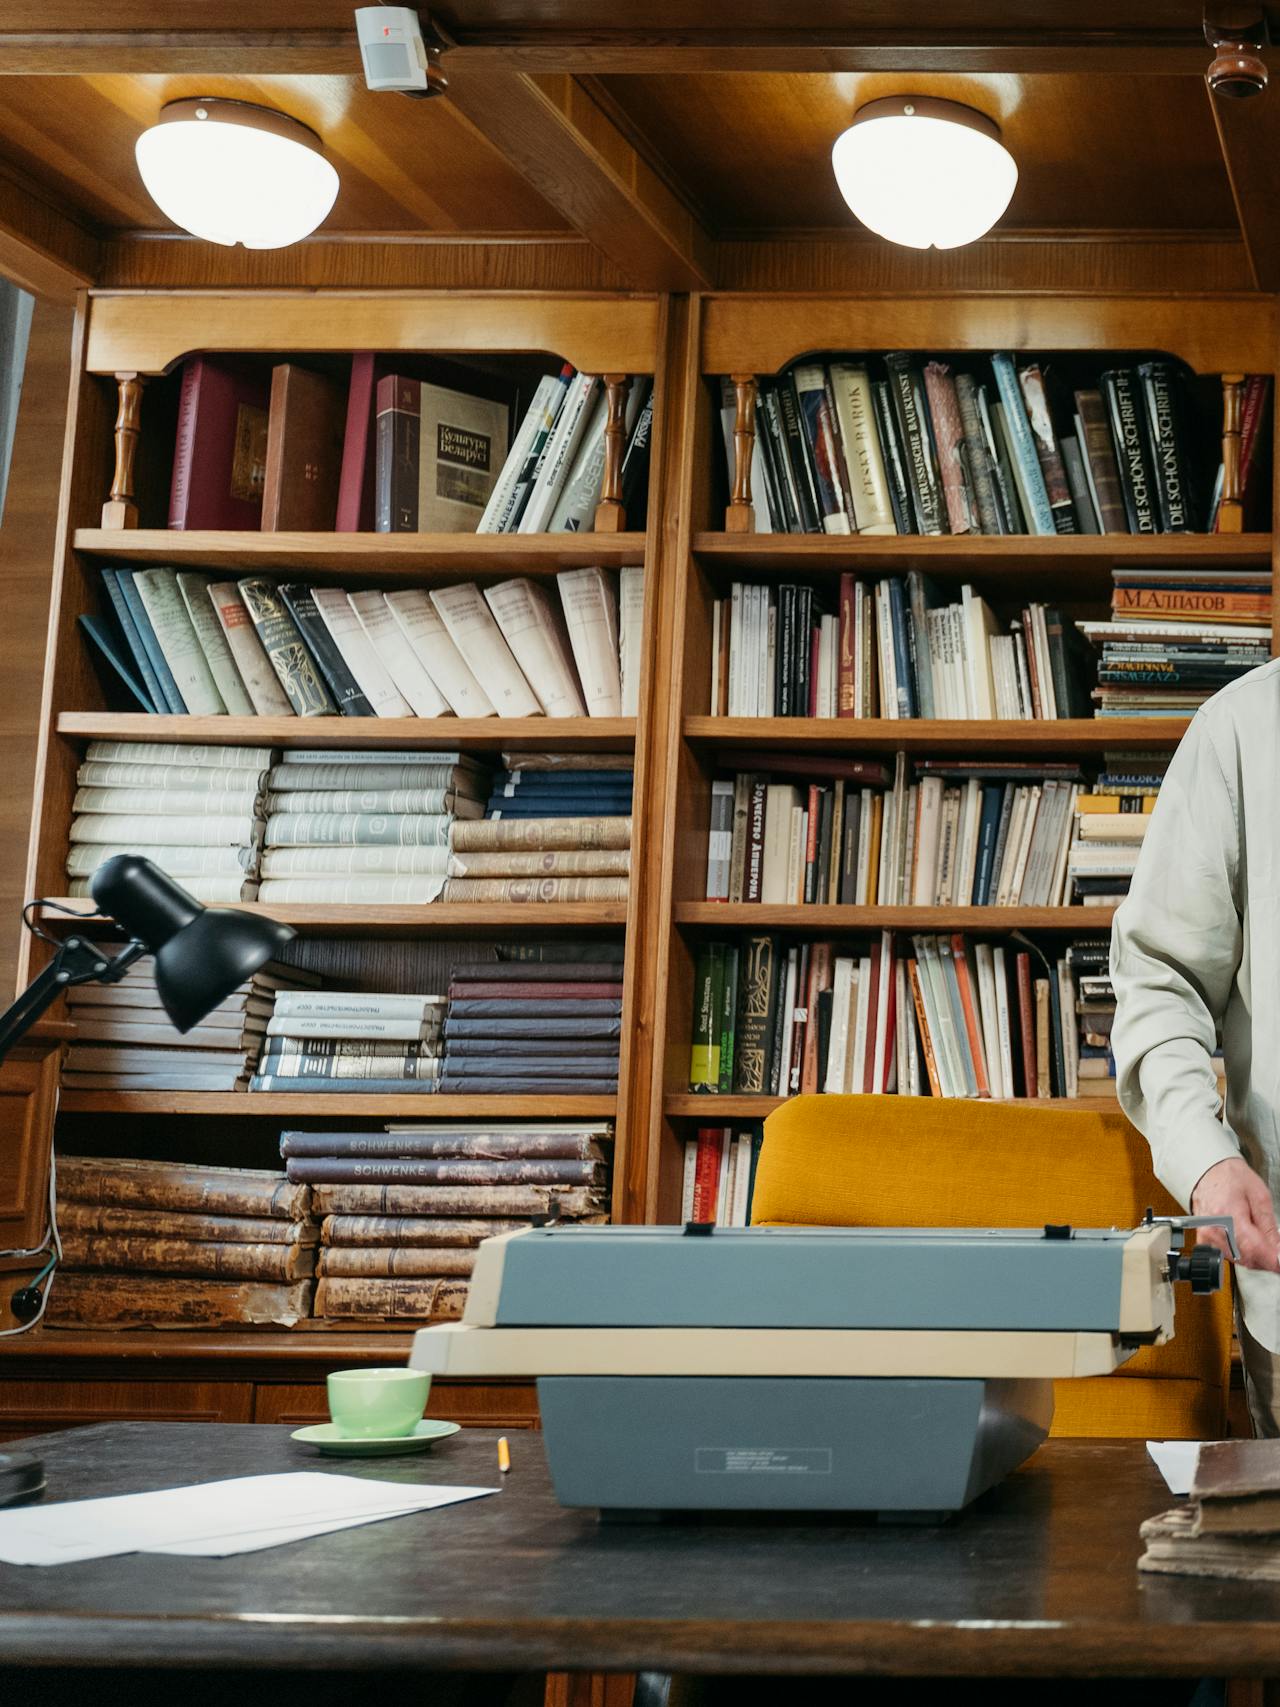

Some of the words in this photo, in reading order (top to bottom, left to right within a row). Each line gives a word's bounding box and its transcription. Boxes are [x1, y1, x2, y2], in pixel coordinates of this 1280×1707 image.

[848, 385, 866, 441] BAROK
[898, 372, 919, 431] BAUKUNST
[440, 427, 486, 449] Культура
[440, 438, 487, 463] Беларусі
[855, 447, 875, 496] ČESKÝ
[909, 433, 933, 514] ALTRUSSISCHE
[1126, 448, 1150, 507] SCHÖNE
[1160, 440, 1182, 500] SCHÖNE
[1137, 509, 1154, 532] DIE
[1166, 502, 1185, 526] DIE
[1107, 662, 1175, 672] PANKIEWICZ
[1108, 775, 1162, 785] ОКОТОВ
[699, 976, 712, 1013] Structures
[699, 1014, 709, 1033] Steel
